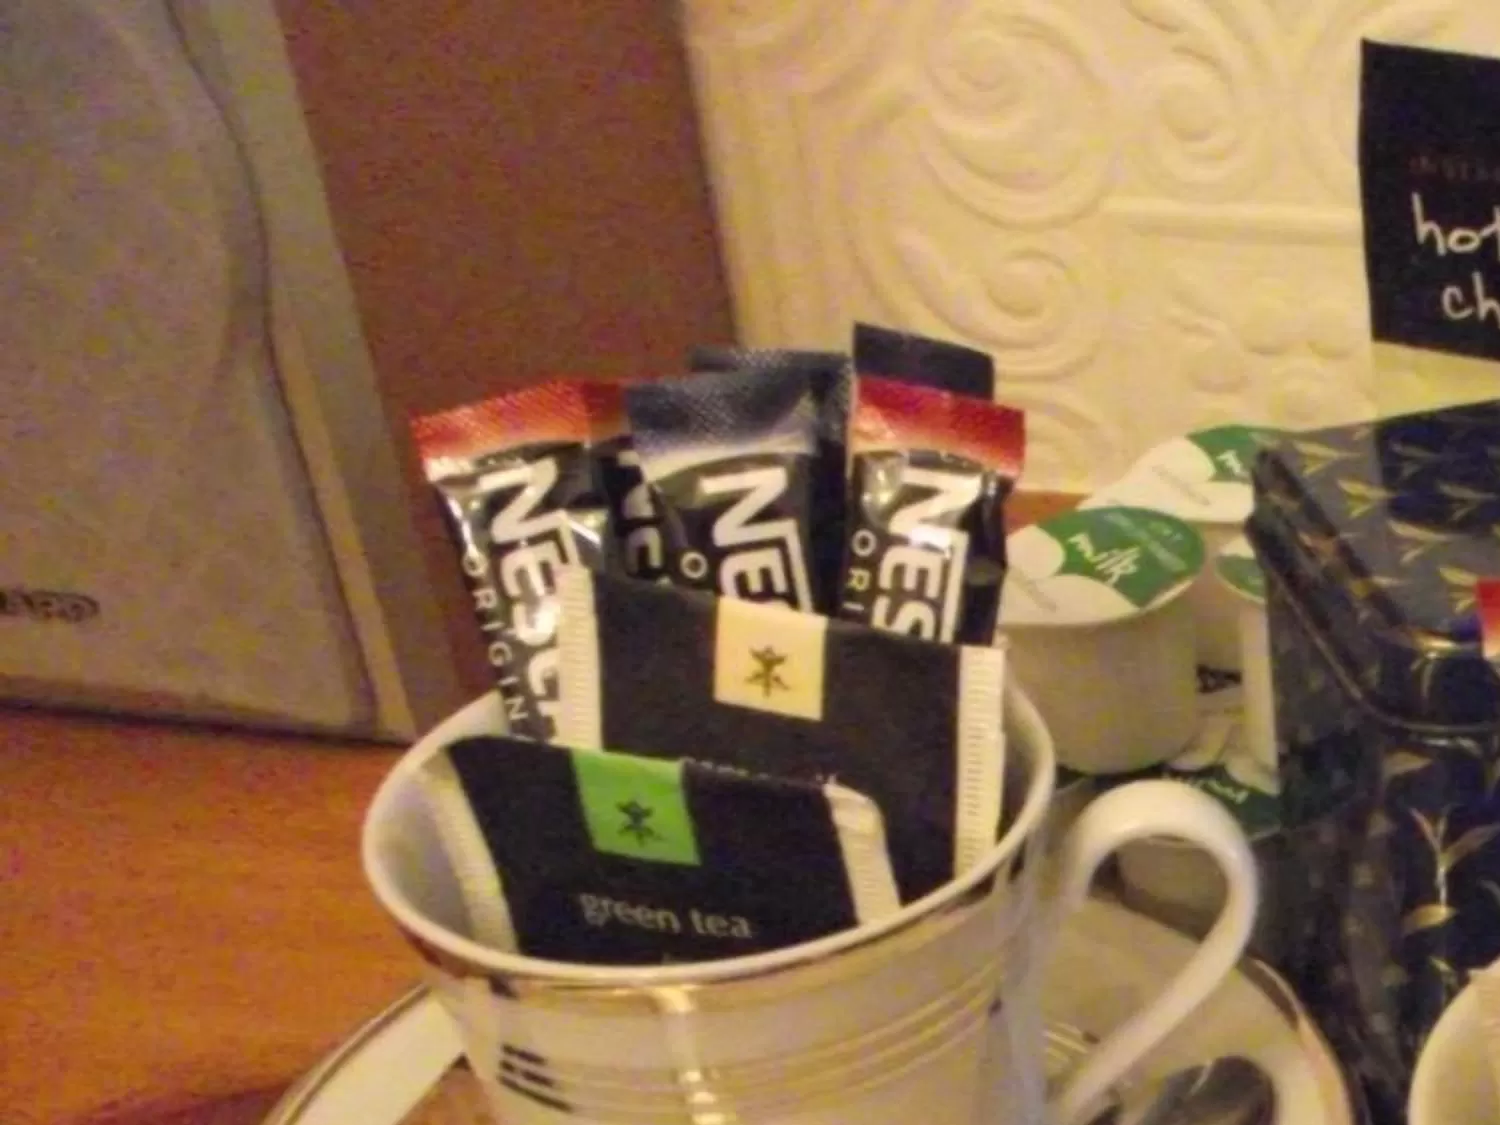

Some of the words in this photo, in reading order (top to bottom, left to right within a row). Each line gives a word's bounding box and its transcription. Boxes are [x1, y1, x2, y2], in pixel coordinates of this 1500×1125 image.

[462, 549, 532, 742] ORIGIN
[579, 893, 682, 934] green
[689, 909, 753, 939] tea
